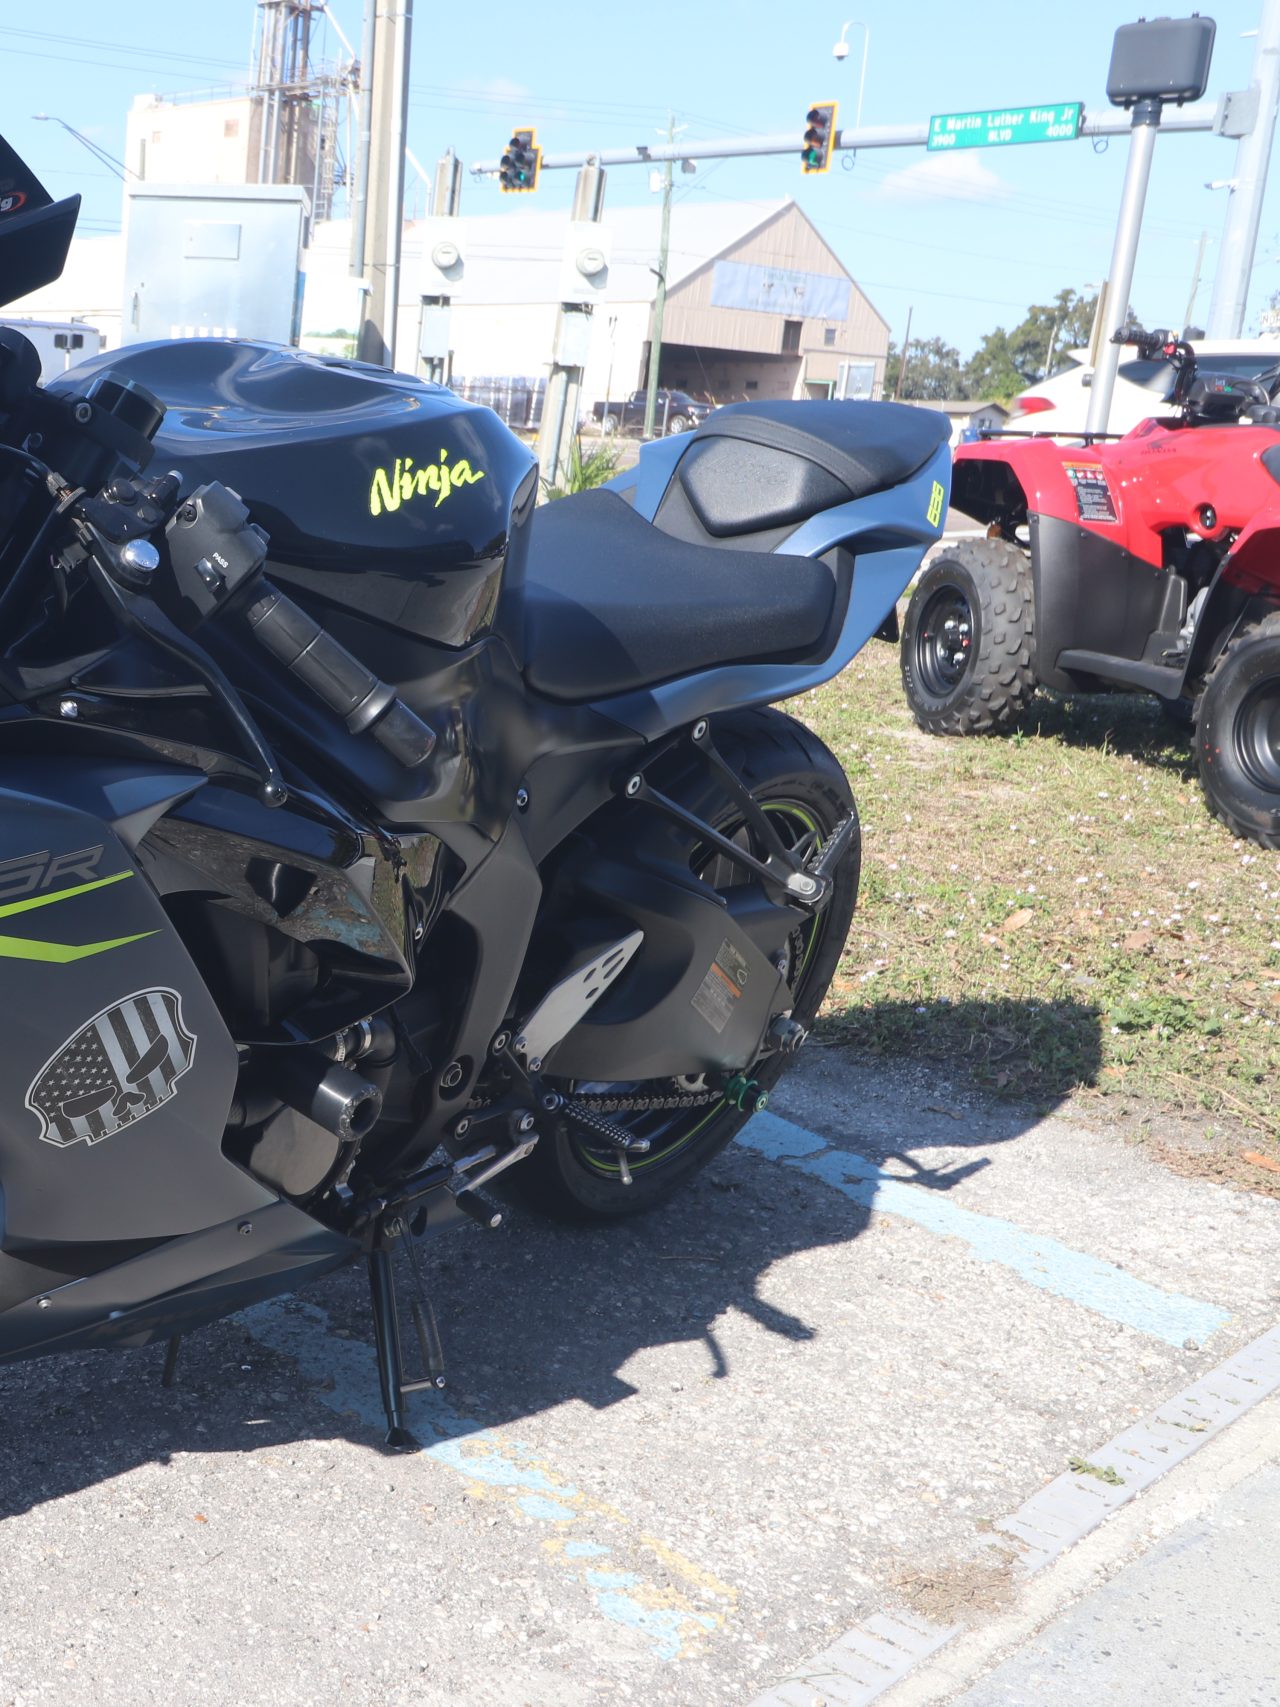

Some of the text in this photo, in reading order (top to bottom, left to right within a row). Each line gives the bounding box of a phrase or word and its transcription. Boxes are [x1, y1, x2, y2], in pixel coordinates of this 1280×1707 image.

[933, 107, 1073, 132] E Martin Luther King Jr
[931, 124, 1073, 147] 3900 BLVD 4000
[370, 448, 485, 517] Ninja
[212, 551, 228, 569] PASS
